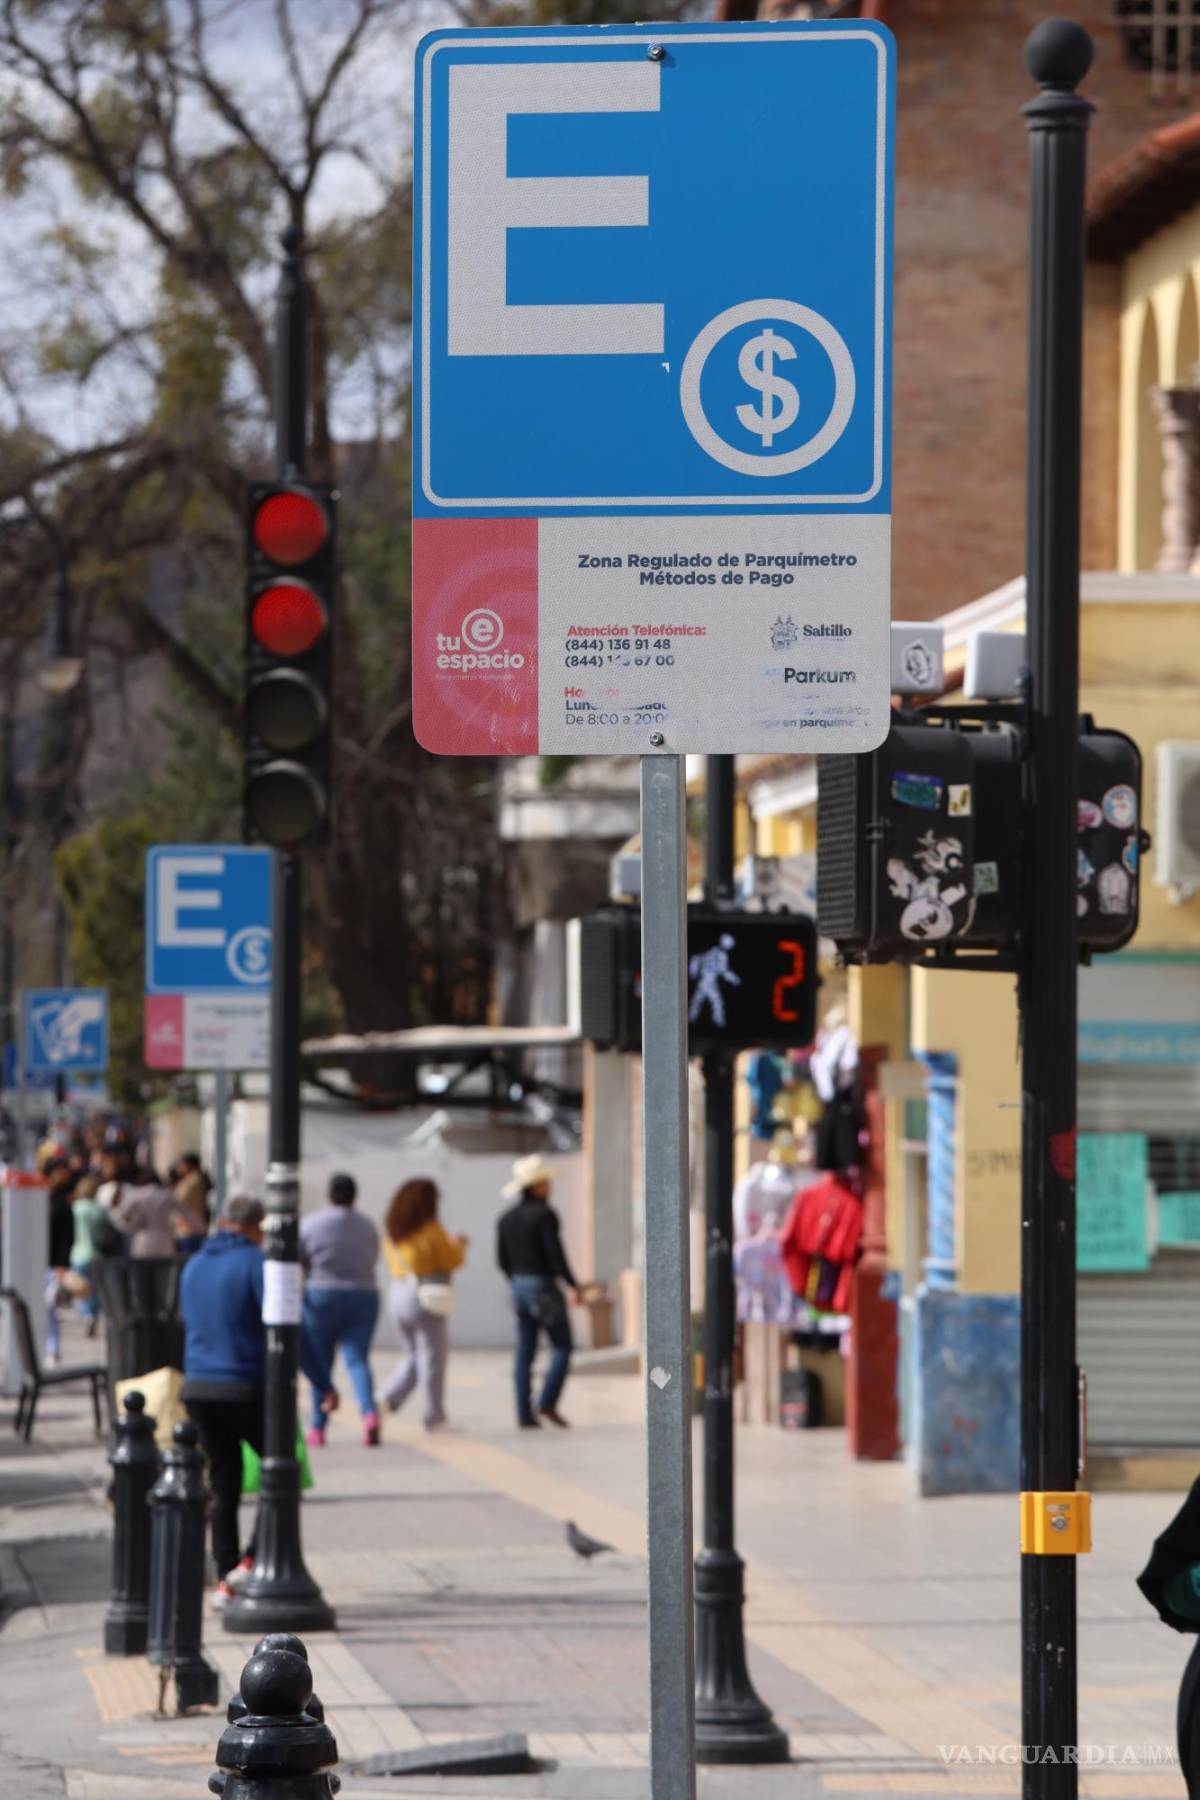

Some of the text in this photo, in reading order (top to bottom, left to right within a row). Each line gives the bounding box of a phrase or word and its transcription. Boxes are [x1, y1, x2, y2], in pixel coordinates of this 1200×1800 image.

[448, 61, 665, 356] E
[578, 552, 858, 571] Zona Regulado de Parquímetro
[639, 570, 795, 588] Métodos de Pago
[567, 624, 707, 636] Atención Telefónica:
[803, 624, 852, 637] Saltillo
[435, 633, 461, 651] tu
[565, 639, 671, 651] (844) 136 91 48
[435, 649, 525, 672] espacio
[565, 655, 603, 668] (844)
[655, 655, 675, 666] 00
[566, 713, 668, 725] De 8:00 a 20:0
[156, 856, 225, 947] E
[772, 939, 805, 1022] 2
